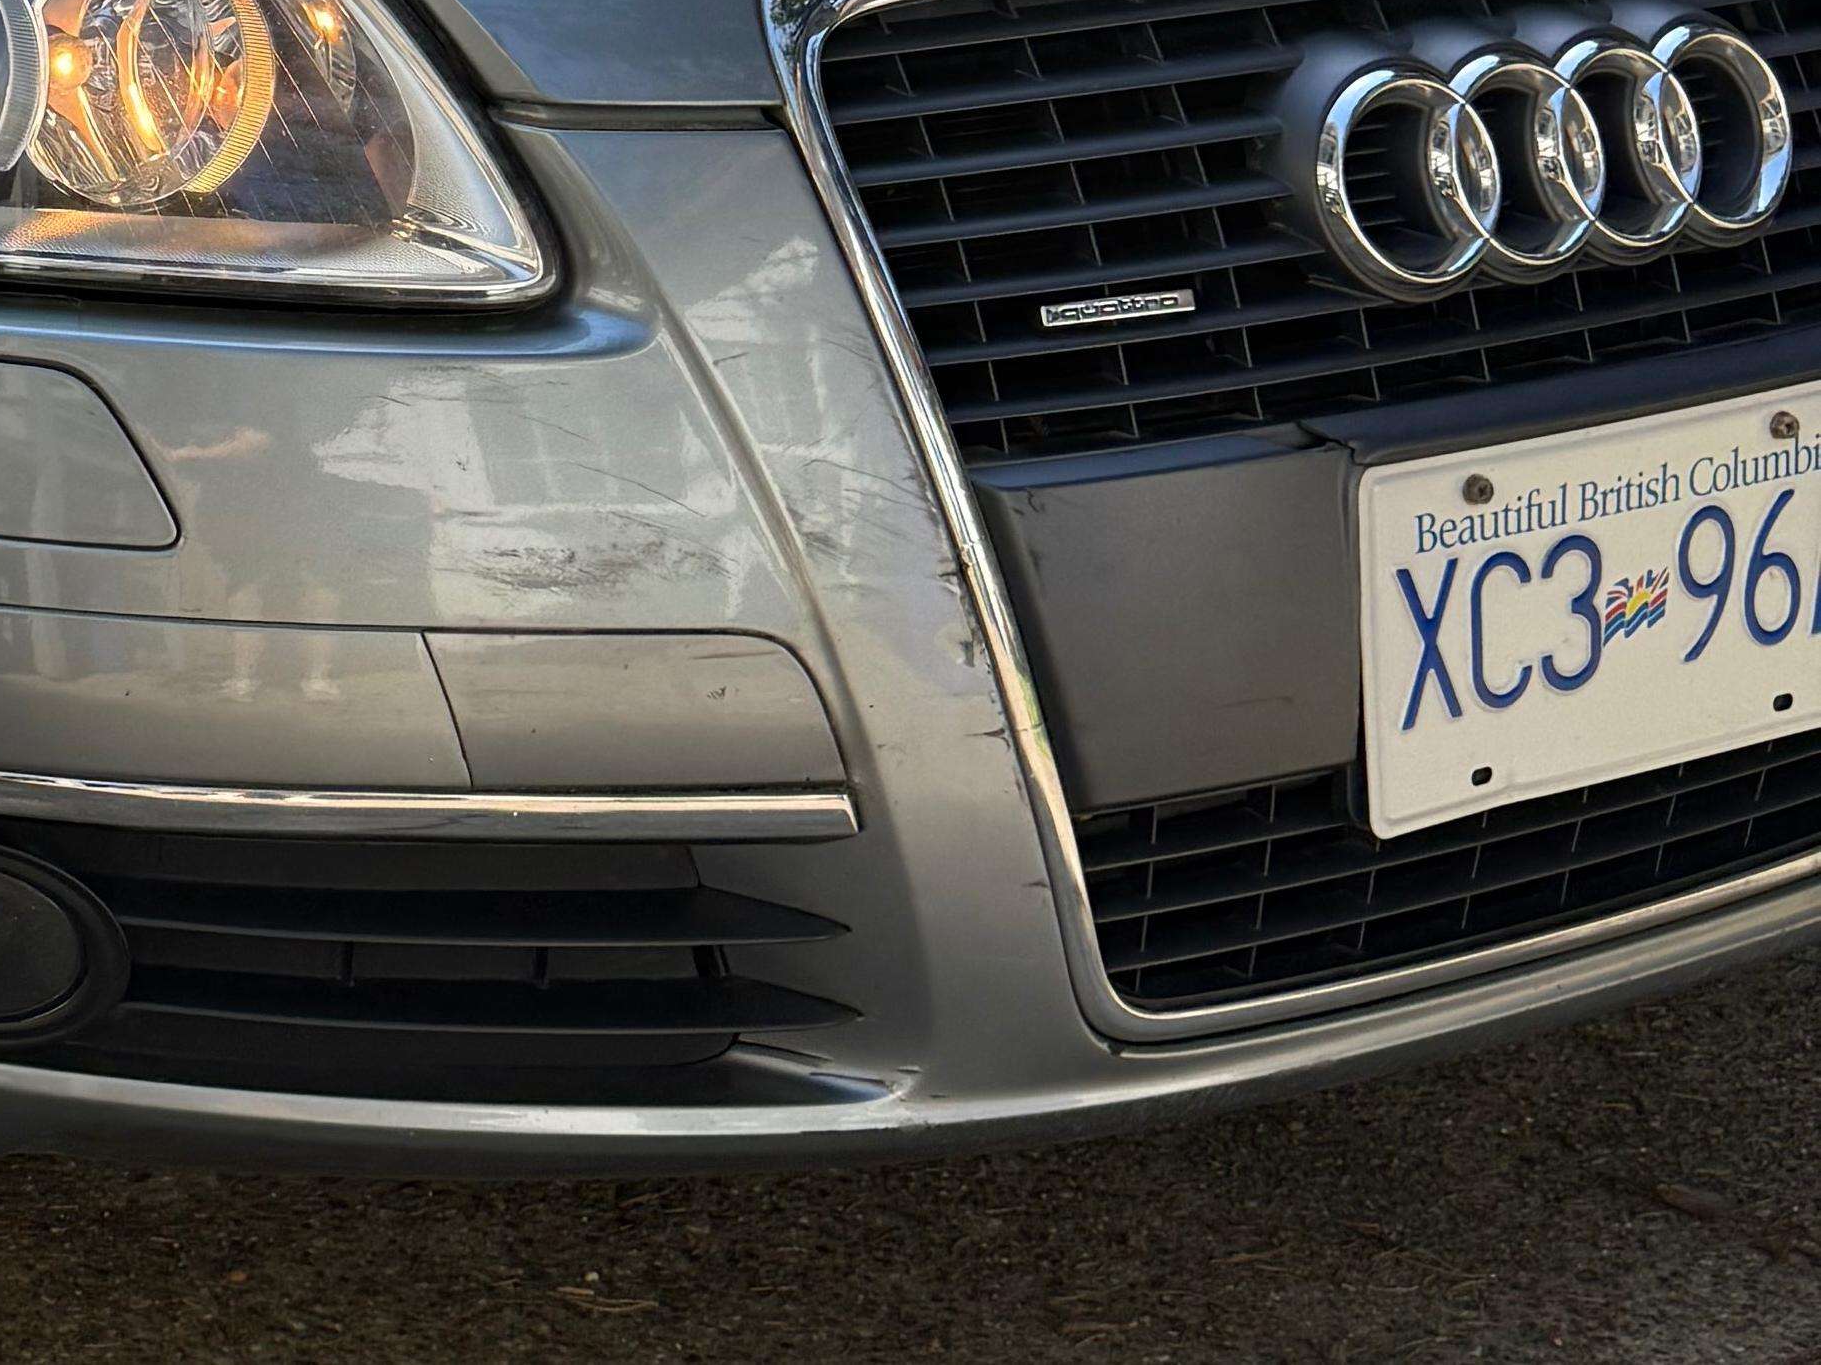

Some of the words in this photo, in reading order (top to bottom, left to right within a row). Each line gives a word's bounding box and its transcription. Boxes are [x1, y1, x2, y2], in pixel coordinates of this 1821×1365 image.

[1415, 484, 1567, 553] Beautiful
[1579, 463, 1680, 522] British
[1396, 534, 1602, 732] XC3
[1678, 488, 1821, 664] 96
